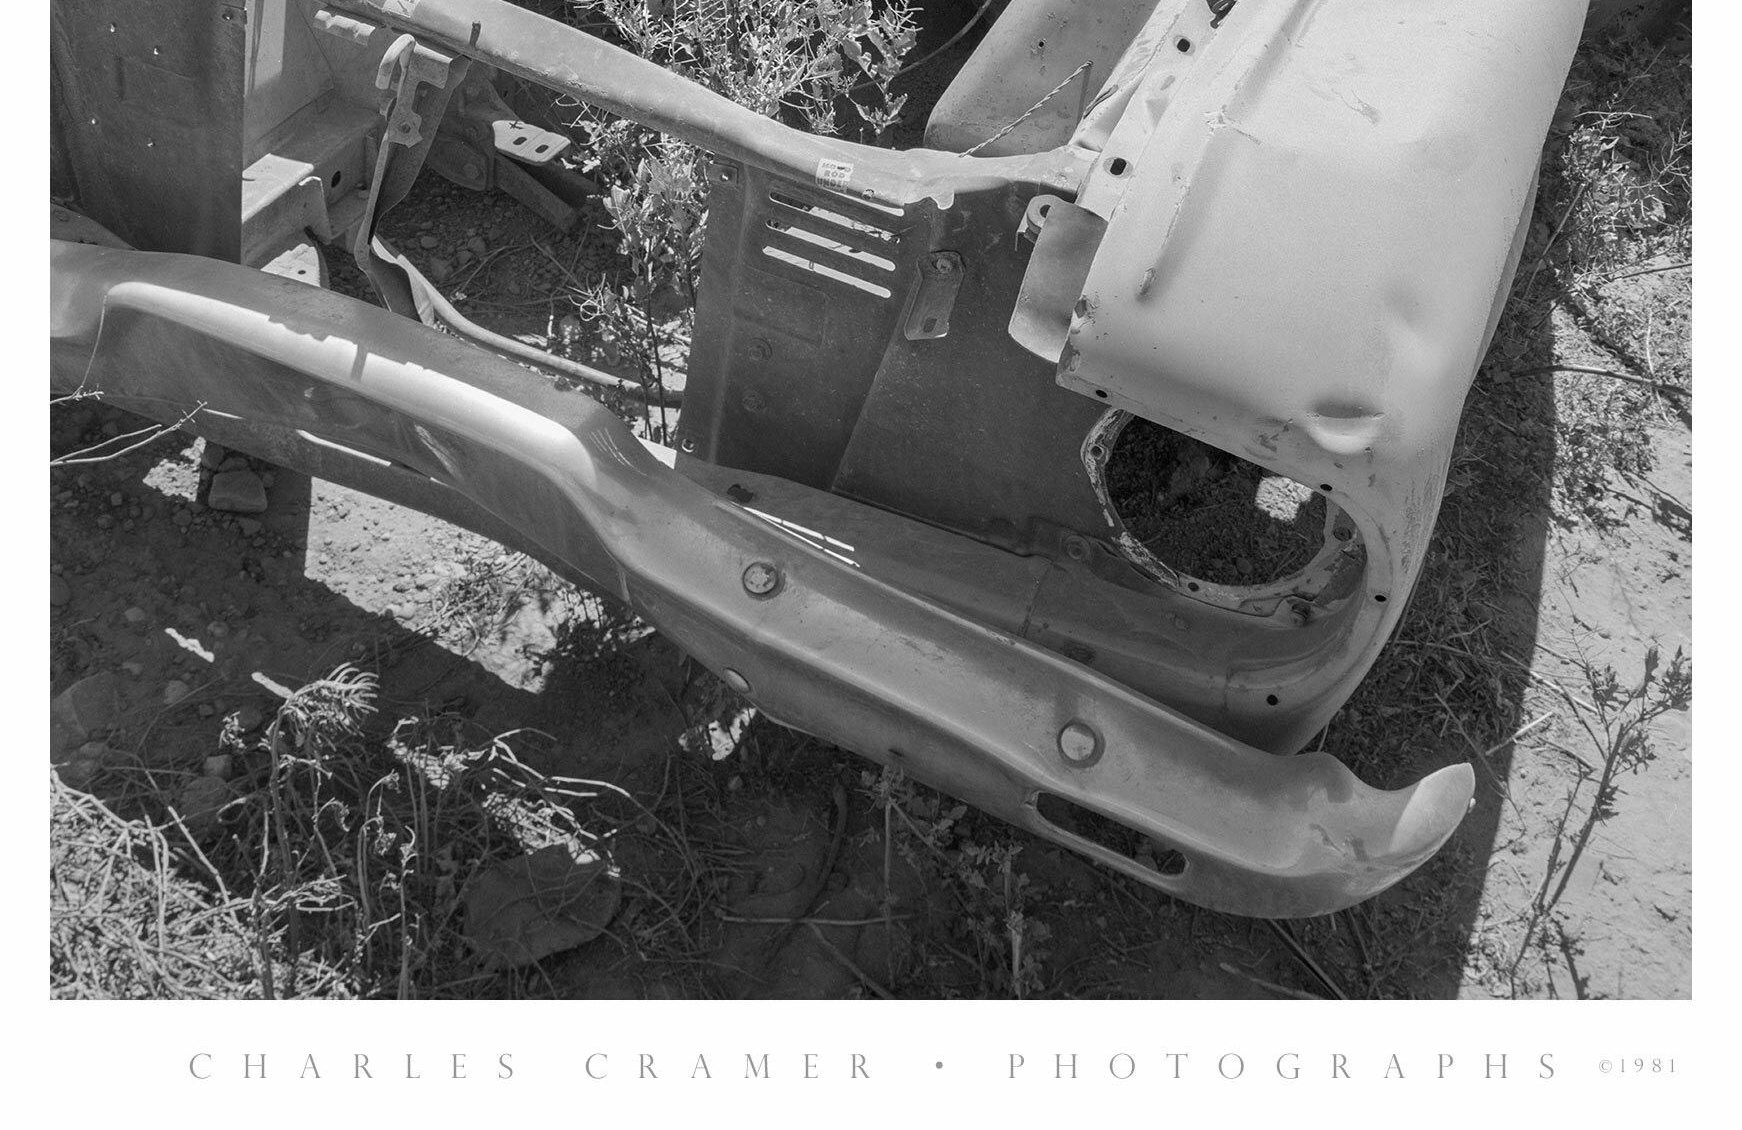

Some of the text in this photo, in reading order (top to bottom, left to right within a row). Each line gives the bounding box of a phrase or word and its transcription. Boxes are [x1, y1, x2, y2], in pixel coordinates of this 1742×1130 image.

[822, 163, 851, 172] HOD
[824, 170, 845, 178] ROD
[817, 178, 848, 189] UNDER
